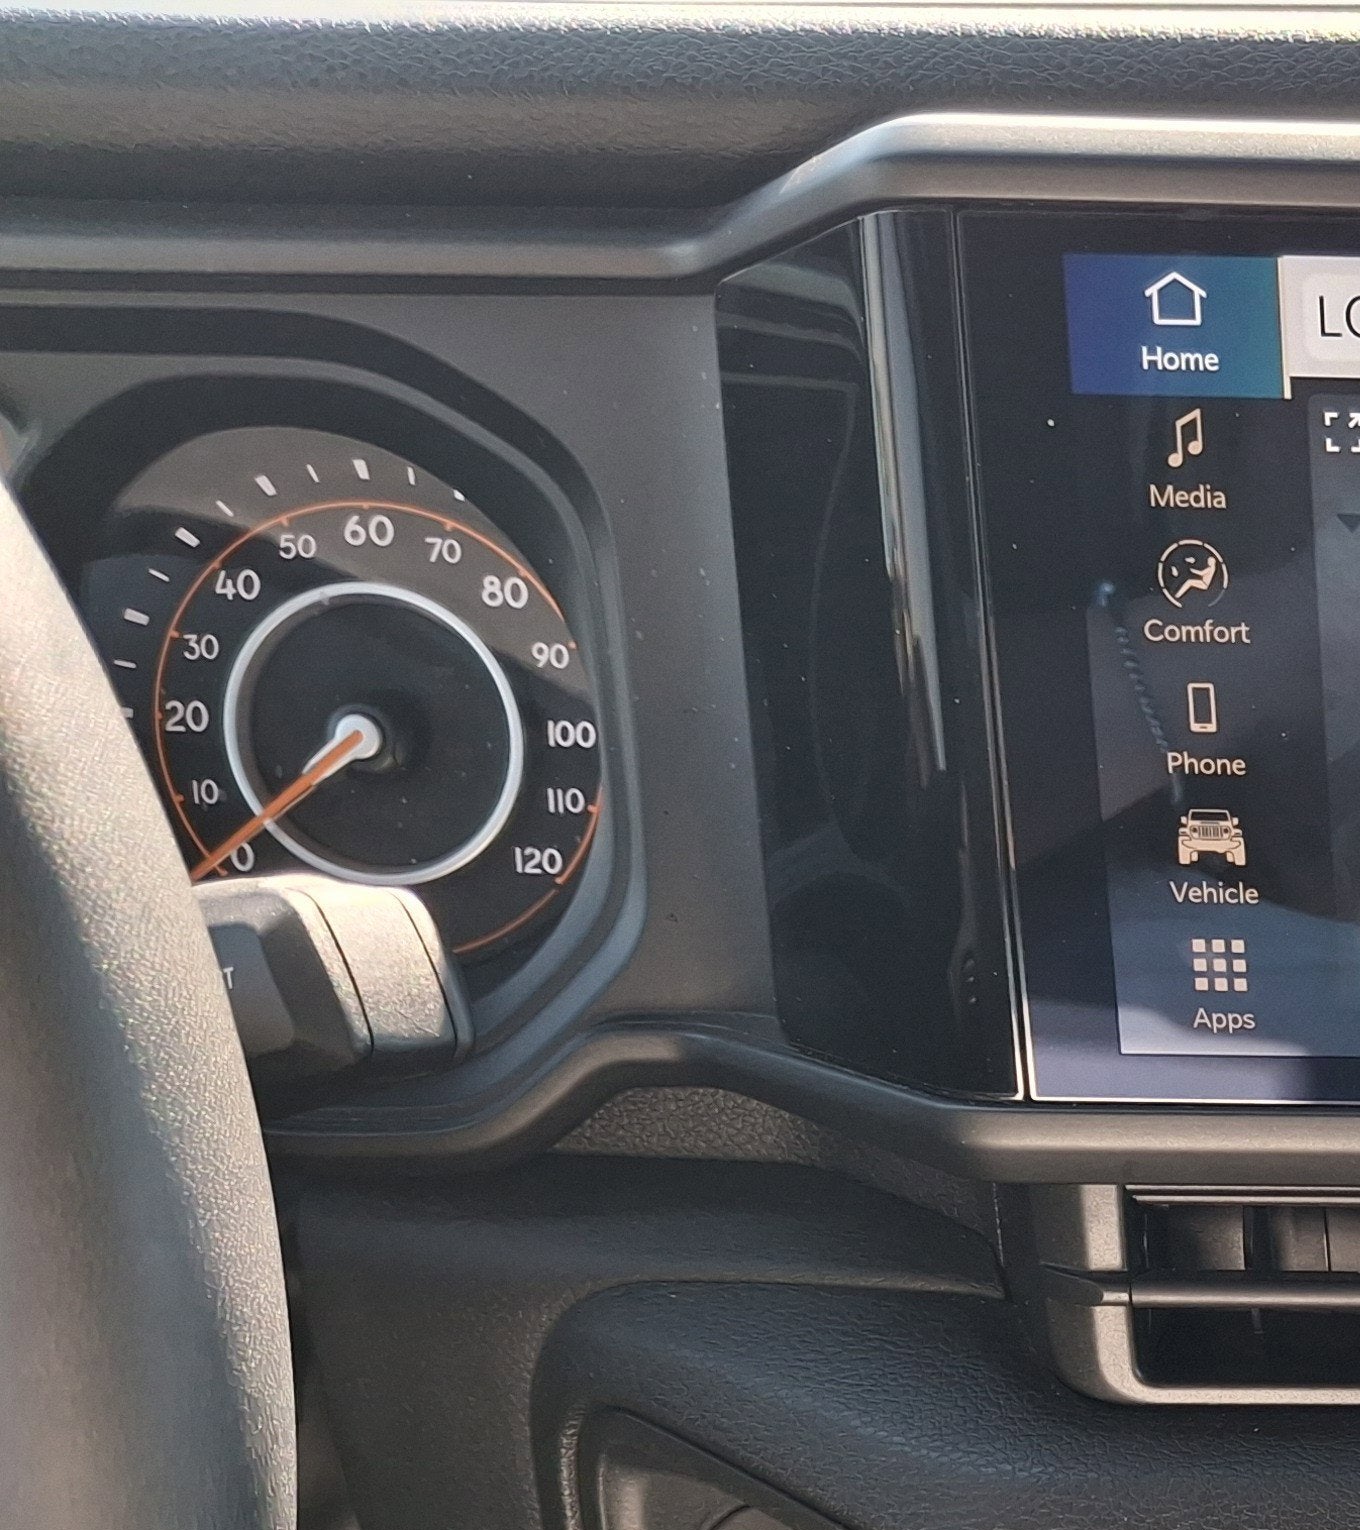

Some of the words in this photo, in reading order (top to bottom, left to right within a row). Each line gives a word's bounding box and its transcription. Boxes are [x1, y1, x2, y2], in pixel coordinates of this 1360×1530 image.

[1140, 346, 1220, 373] Home
[1149, 484, 1227, 510] Media
[343, 514, 395, 547] 60
[278, 534, 318, 559] 50
[424, 537, 463, 564] 70
[214, 568, 261, 602] 40
[481, 575, 529, 609] 80
[1143, 618, 1251, 645] Comfort
[182, 634, 220, 661] 30
[531, 642, 570, 670] 90
[164, 700, 210, 734] 20
[546, 719, 597, 750] 100
[1166, 751, 1246, 778] Phone
[191, 779, 219, 806] 10
[547, 788, 587, 814] 110
[229, 844, 255, 872] 0
[513, 846, 563, 876] 120
[1168, 879, 1260, 905] Vehicle
[1193, 1007, 1256, 1033] Apps
